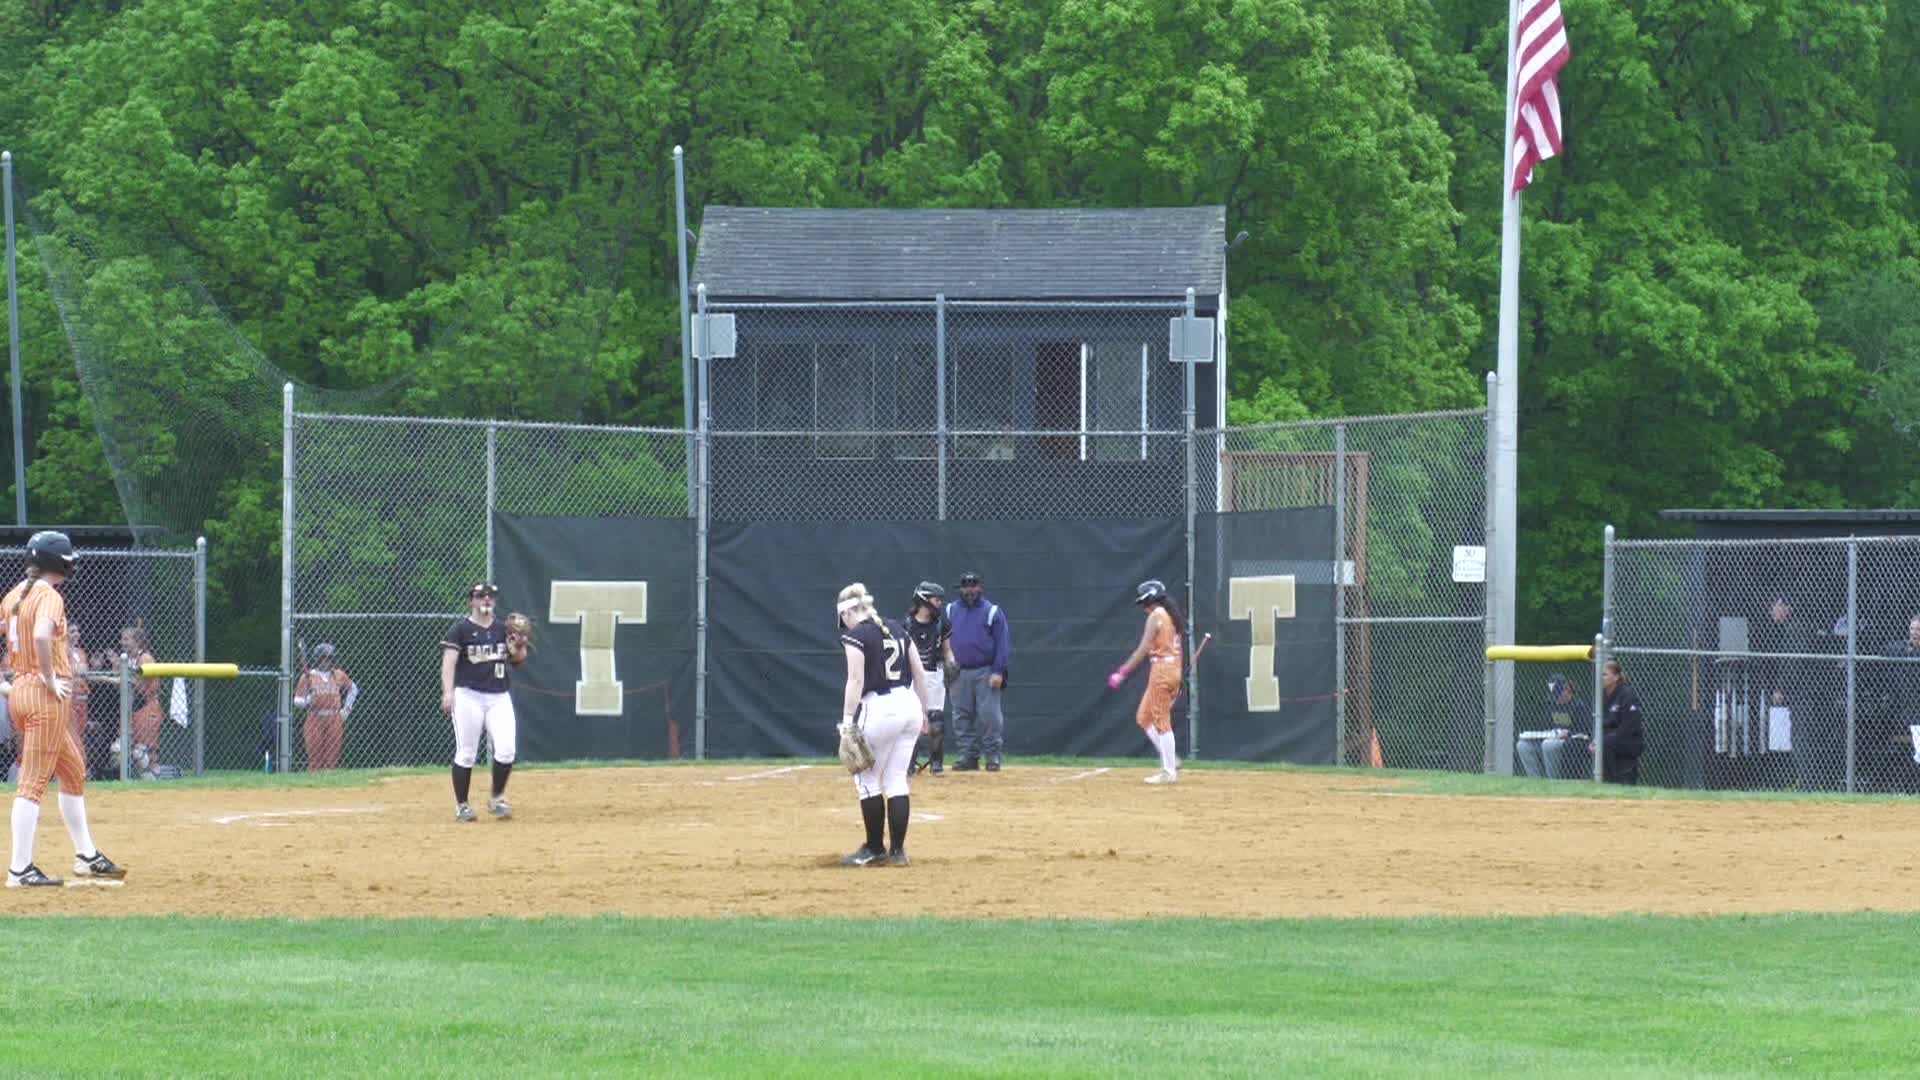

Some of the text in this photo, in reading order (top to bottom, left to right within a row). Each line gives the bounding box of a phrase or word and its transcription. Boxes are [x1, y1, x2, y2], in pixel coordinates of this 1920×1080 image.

[468, 643, 508, 664] EAGLE
[549, 580, 648, 716] T
[1229, 575, 1296, 712] T
